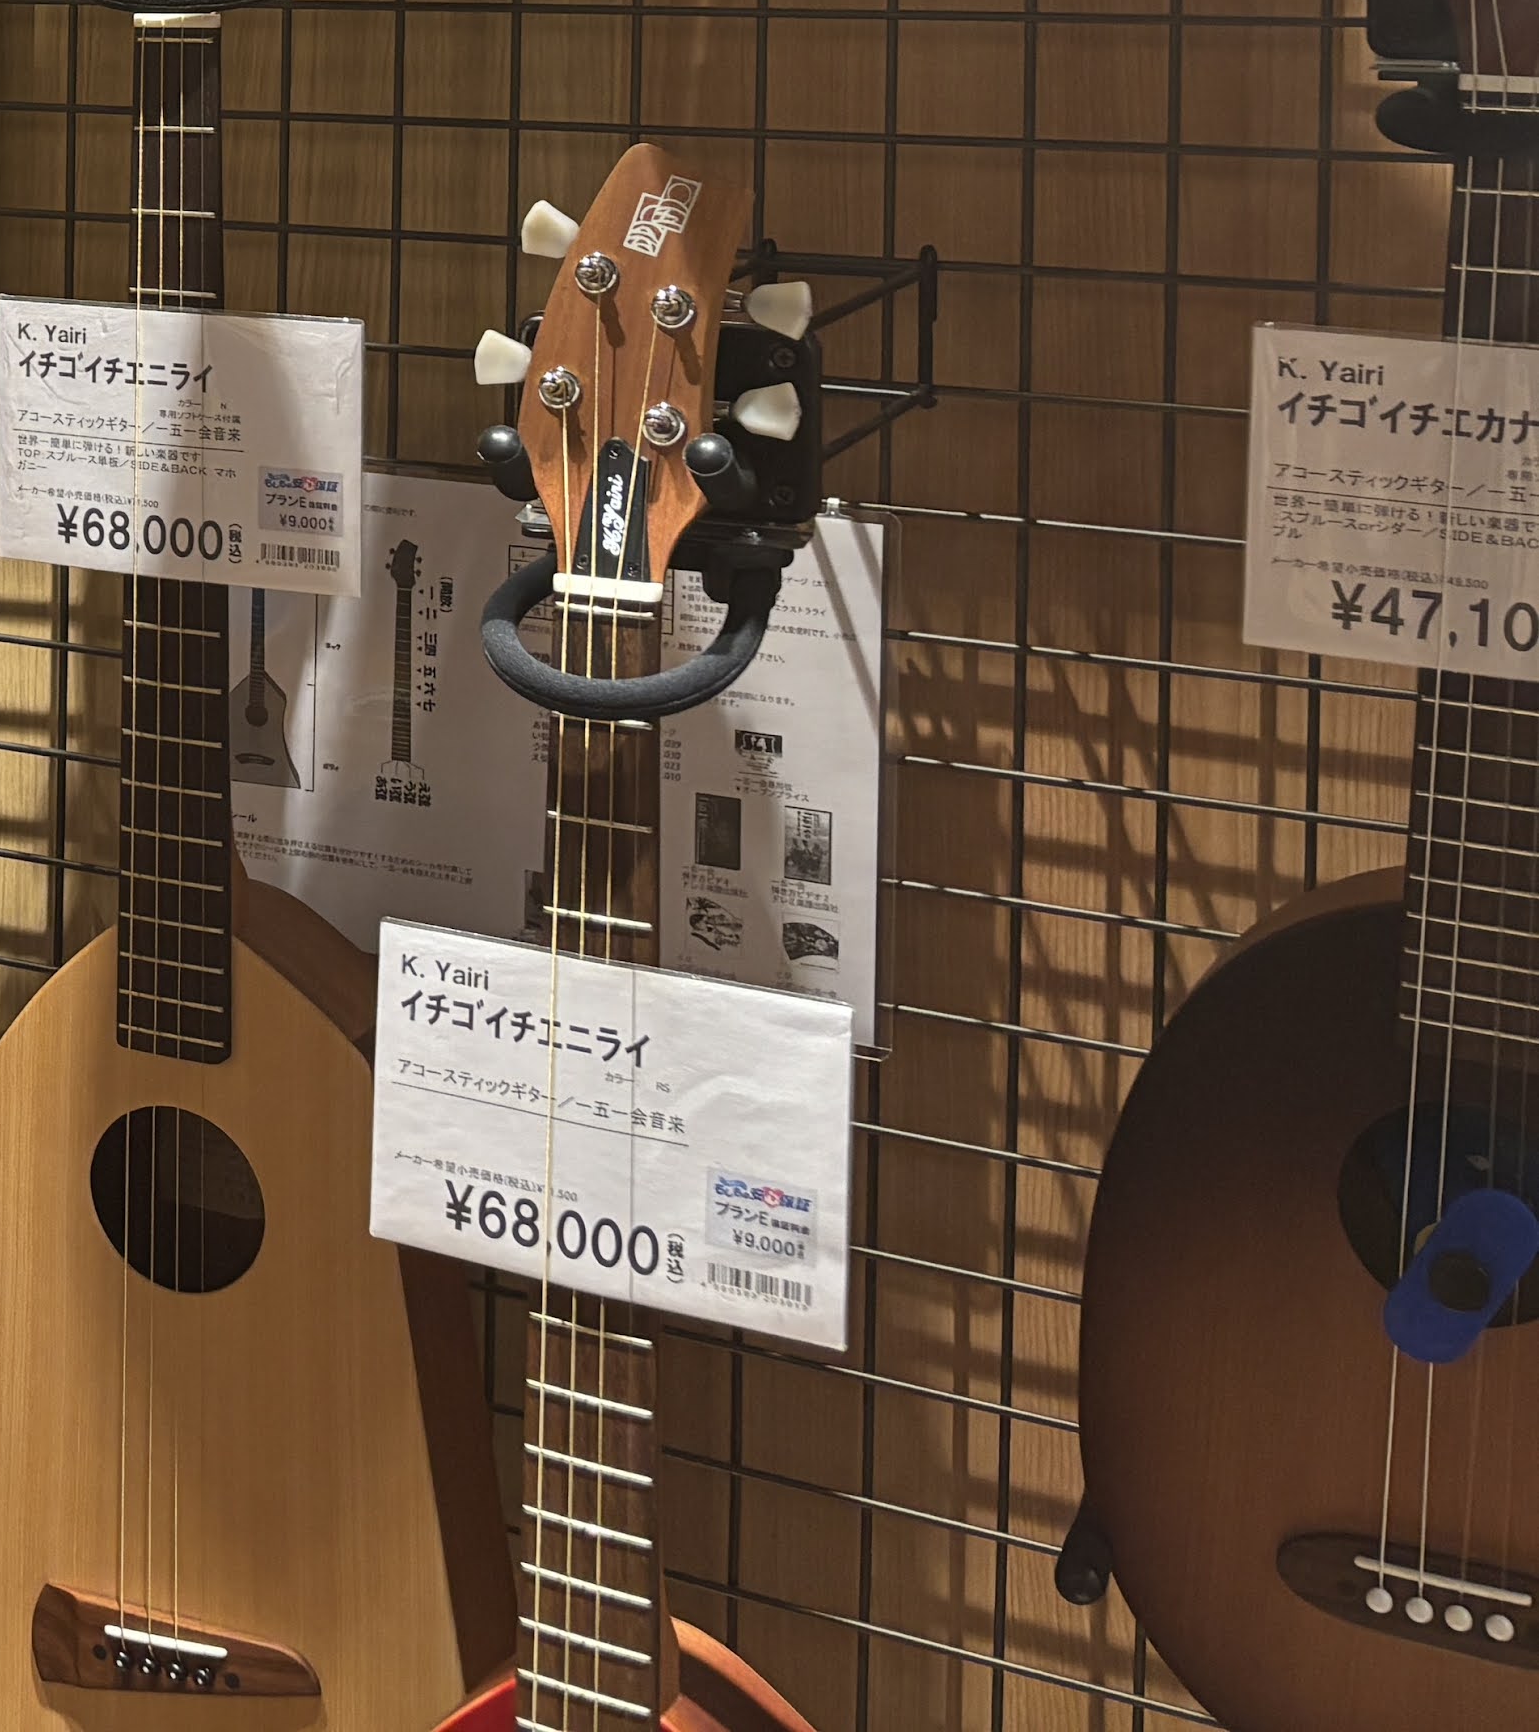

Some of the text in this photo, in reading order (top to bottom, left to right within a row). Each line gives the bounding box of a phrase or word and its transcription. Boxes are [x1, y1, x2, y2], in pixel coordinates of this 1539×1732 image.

[17, 323, 88, 345] K. Yairi
[18, 349, 214, 393] イチゴイチエニライ
[1278, 356, 1385, 386] K. Yairi
[1278, 392, 1539, 445] イチゴイチエカナ
[57, 502, 224, 561] ¥68,000
[400, 954, 490, 992] K. Yairi
[400, 989, 652, 1069] イチゴイチエニライ
[444, 1179, 661, 1277] ¥68,000
[715, 1201, 769, 1226] プランE
[667, 1231, 686, 1285] (税込)
[732, 1228, 795, 1257] ¥9,000
